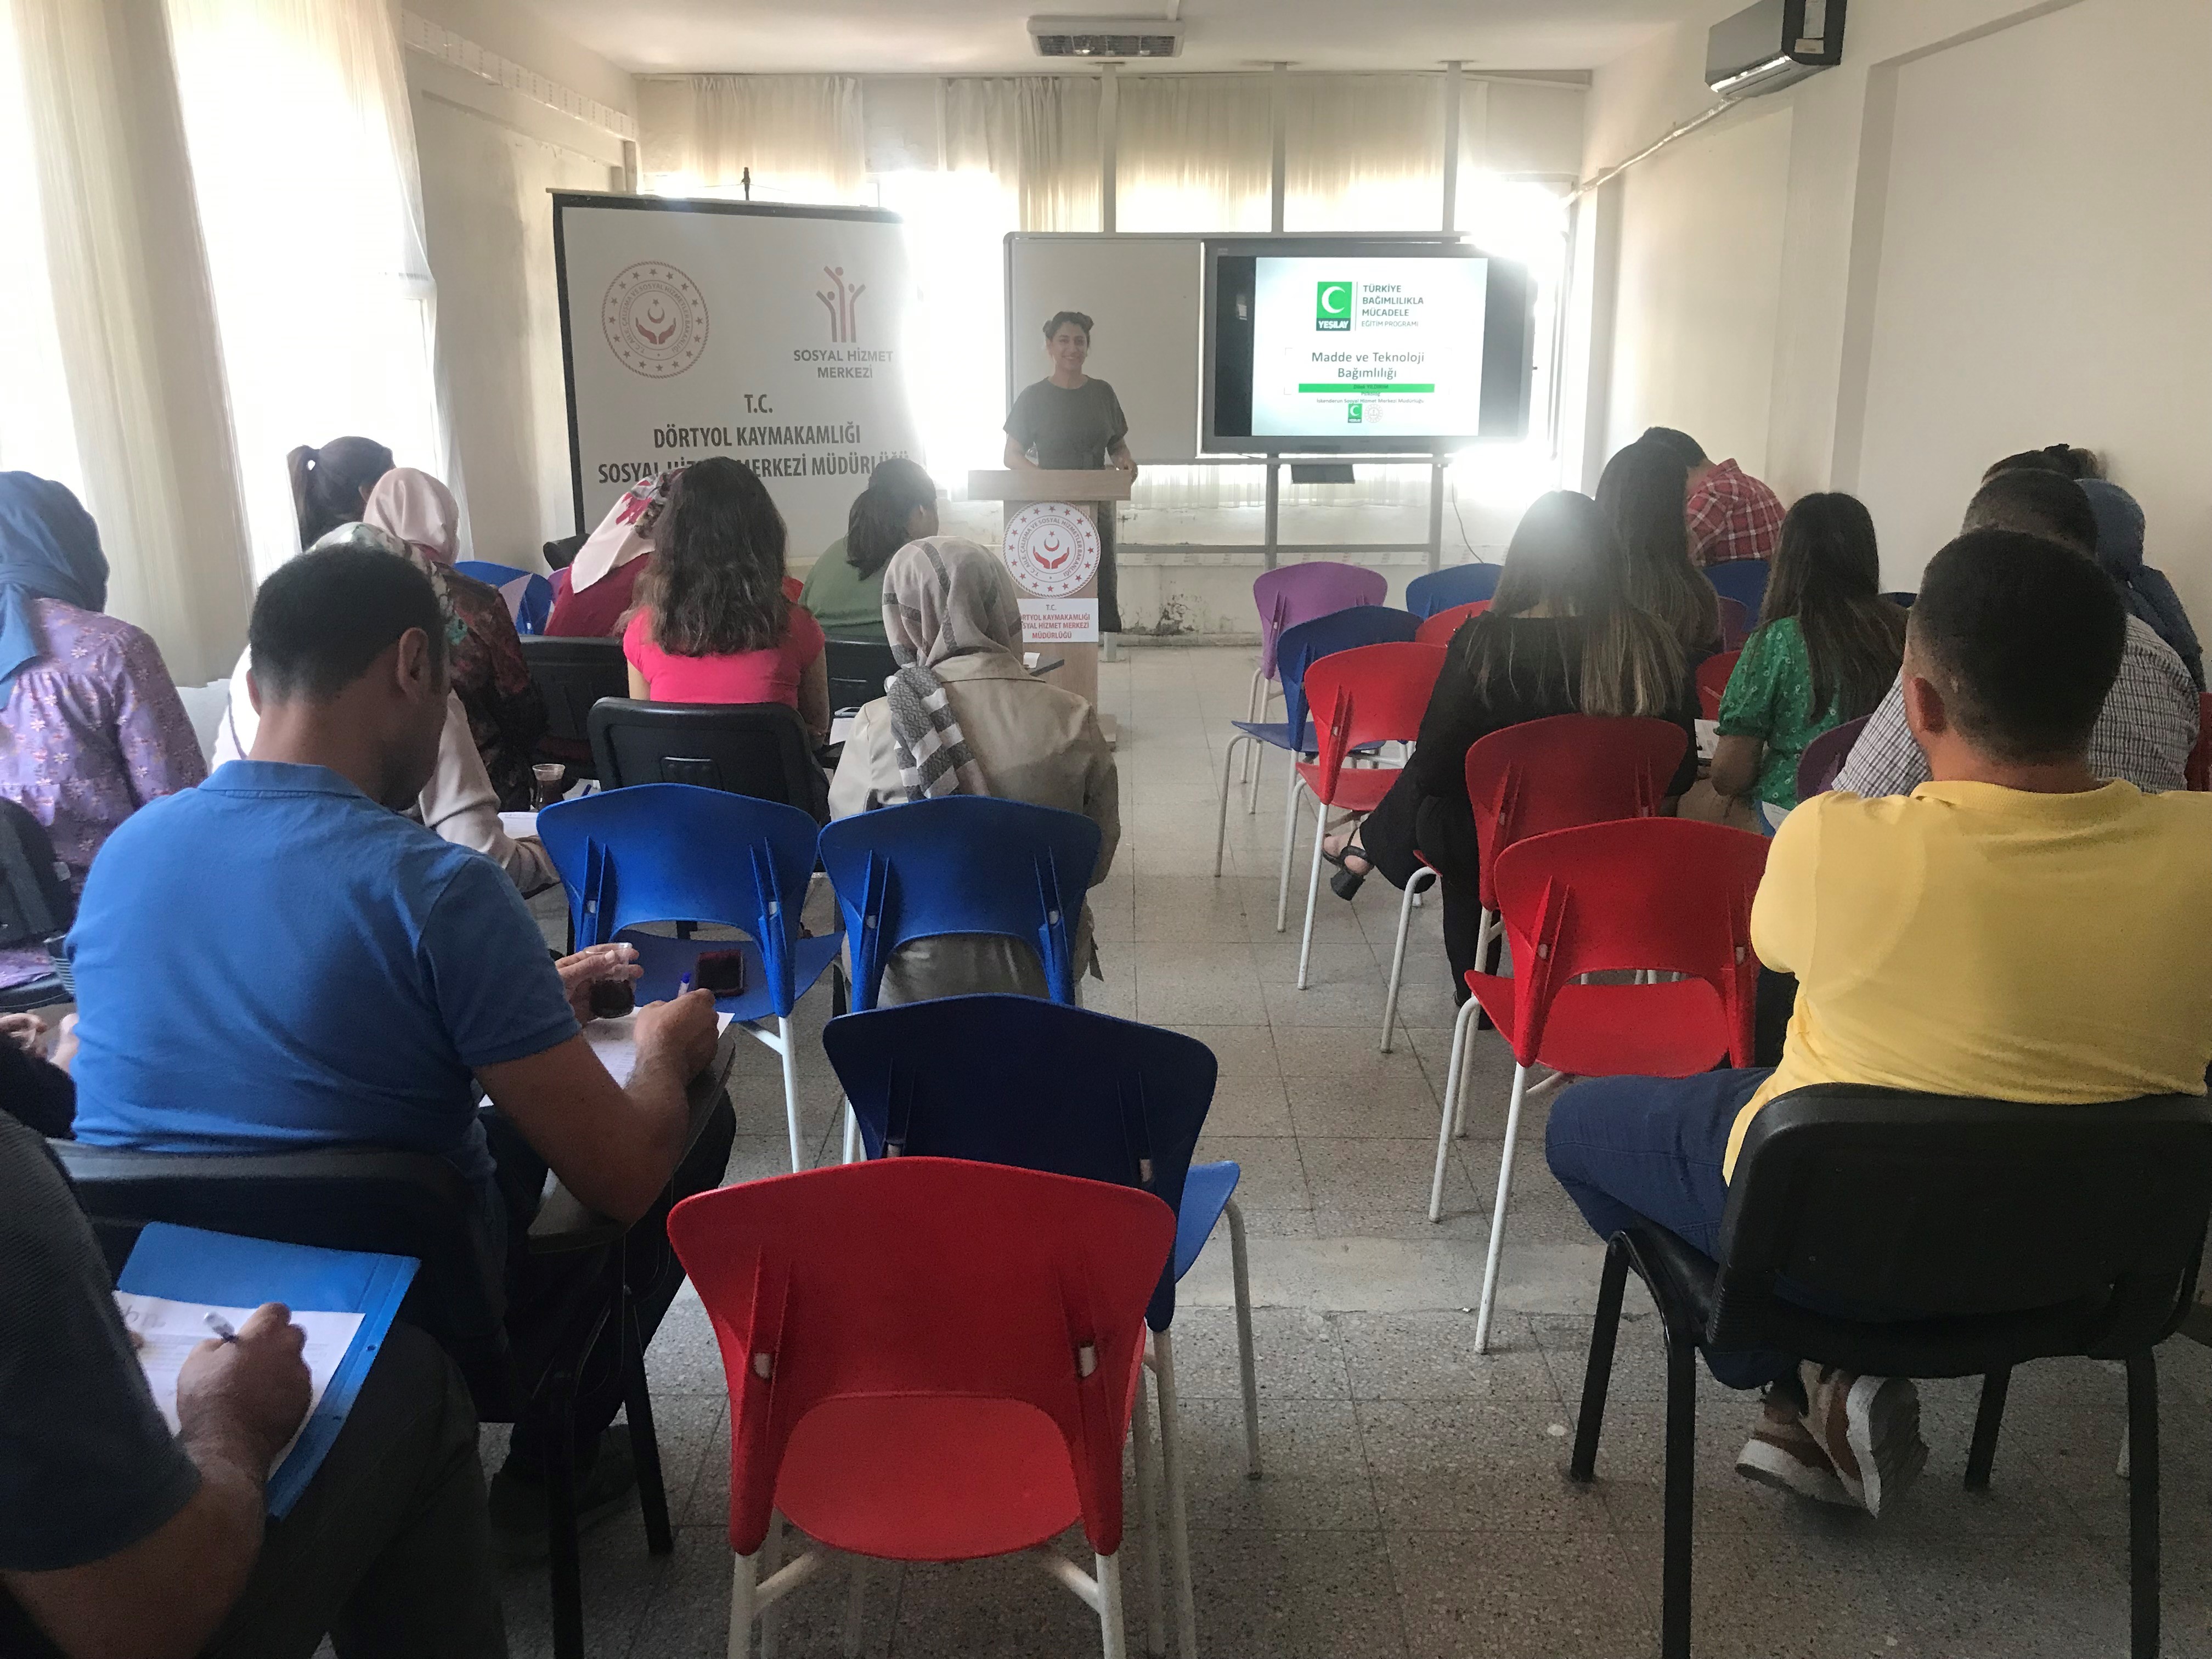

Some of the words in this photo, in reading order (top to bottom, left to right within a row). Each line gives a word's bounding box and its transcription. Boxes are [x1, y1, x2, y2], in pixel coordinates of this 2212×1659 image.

[639, 283, 663, 292] SOSYAL
[1363, 284, 1401, 292] TÜRKİYE
[1363, 295, 1424, 304] BAĞIMLILIKLA
[1362, 308, 1409, 317] MÜCADELE
[793, 349, 843, 362] SOSYAL
[848, 347, 894, 362] HİZMET
[1312, 352, 1352, 362] Madde
[1373, 352, 1425, 364] Teknoloji
[817, 364, 873, 379] MERKEZİ
[1338, 368, 1397, 380] Bağımlılığı
[744, 393, 773, 413] T.C.
[654, 424, 732, 448] DÖRTYOL
[737, 421, 861, 446] KAYMAKAMLIĞI
[1043, 612, 1090, 620] KAYMAKAMLIĞI
